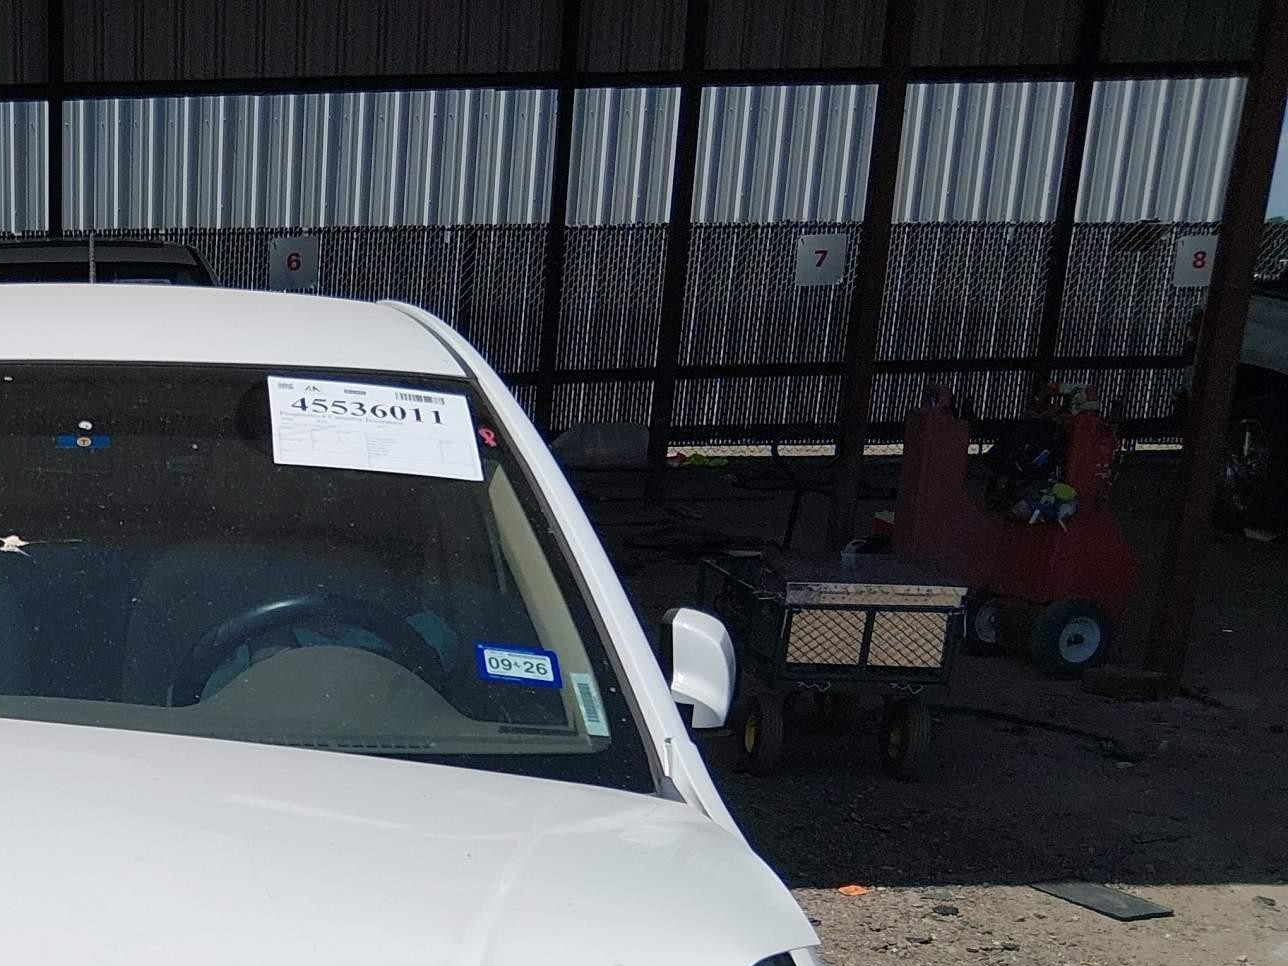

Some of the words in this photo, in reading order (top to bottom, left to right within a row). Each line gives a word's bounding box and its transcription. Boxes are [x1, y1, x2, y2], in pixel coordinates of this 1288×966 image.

[287, 252, 302, 271] 6
[814, 249, 828, 268] 7
[1192, 250, 1208, 269] 8
[291, 397, 445, 424] 45536011
[488, 656, 512, 671] 09
[523, 661, 548, 676] 26
